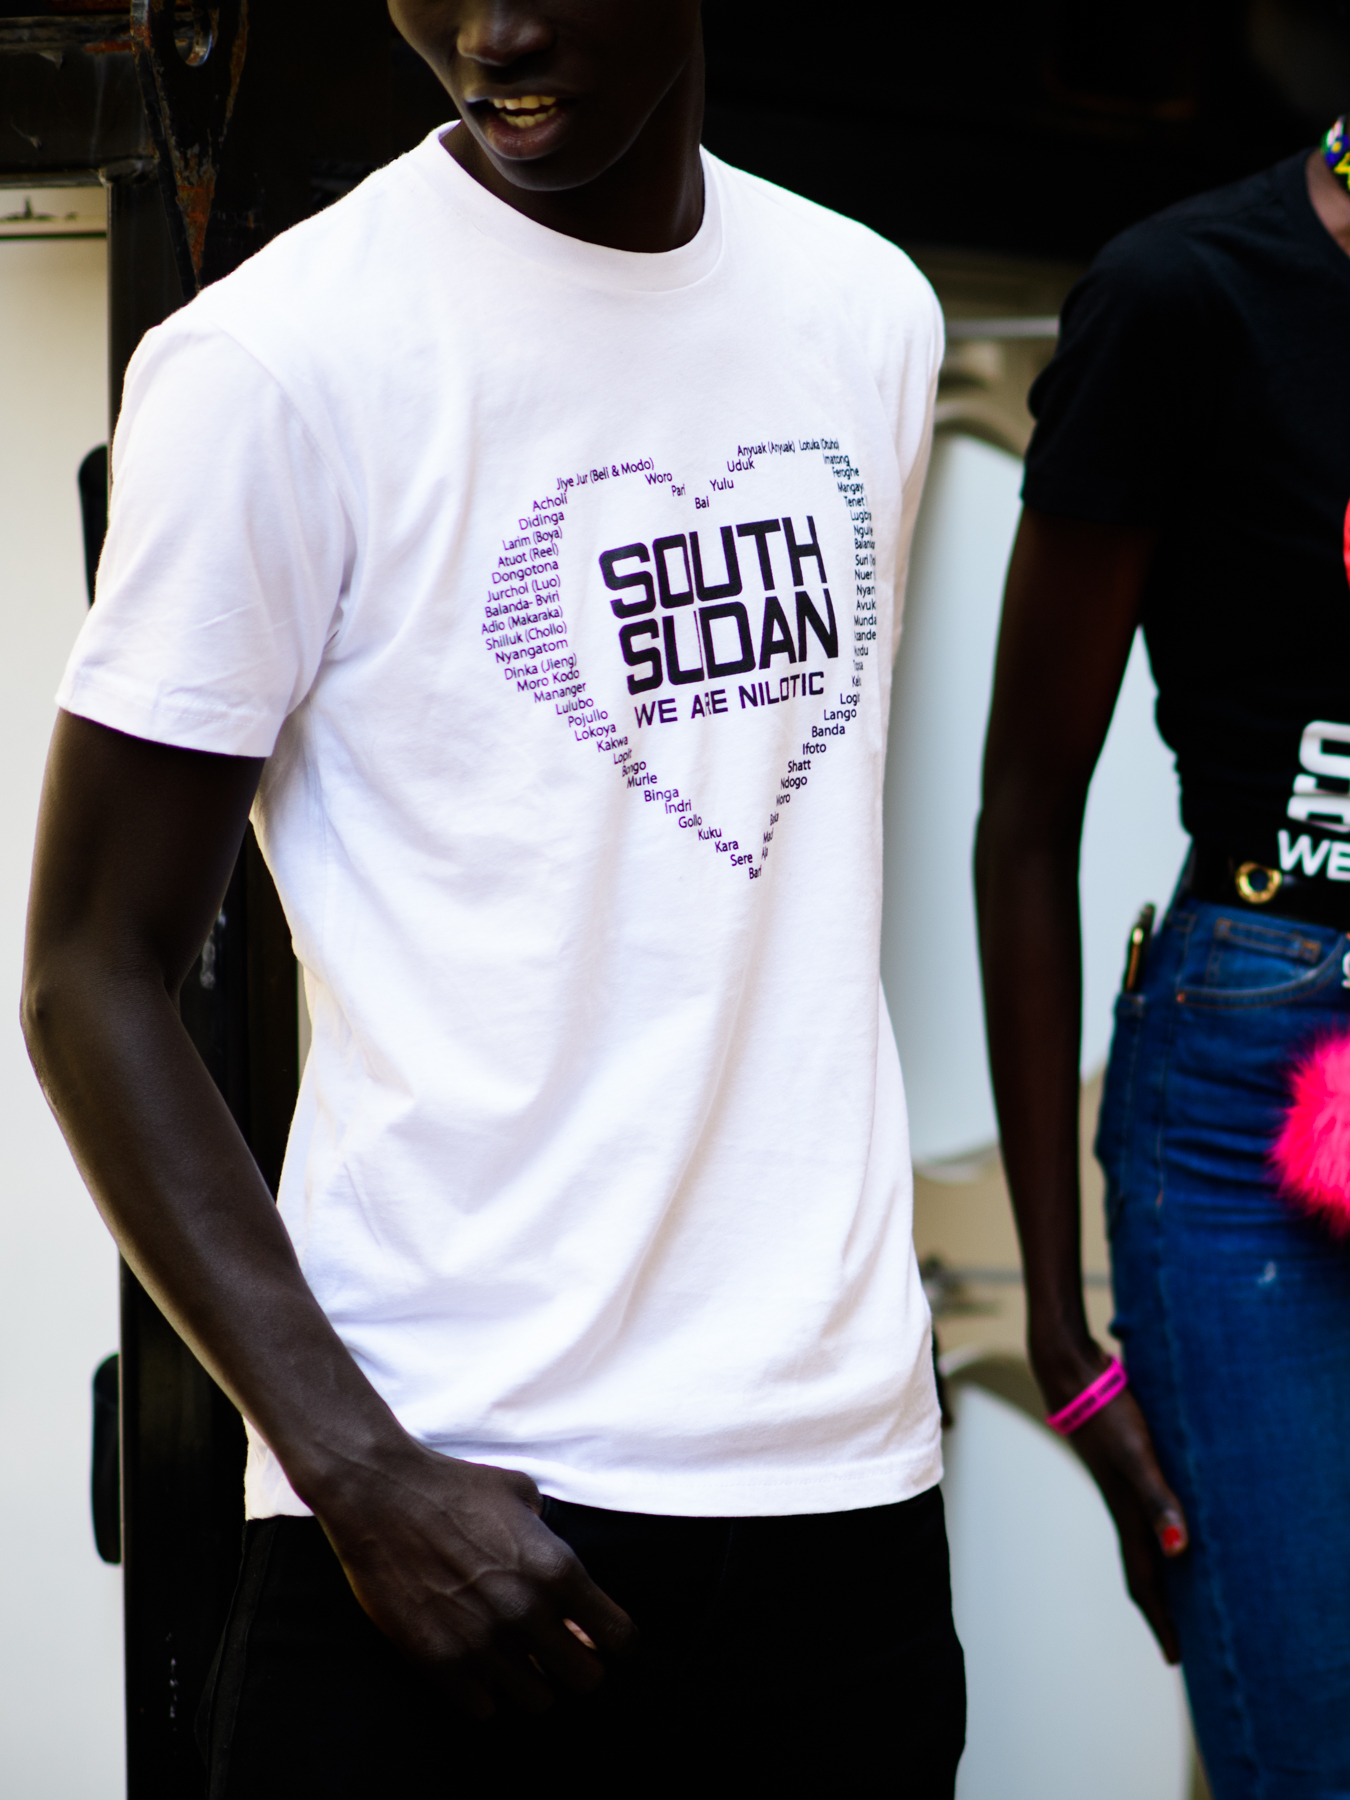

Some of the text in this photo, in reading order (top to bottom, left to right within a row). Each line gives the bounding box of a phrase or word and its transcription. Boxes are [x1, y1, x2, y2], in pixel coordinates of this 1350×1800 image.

[737, 442, 767, 459] Anyuak
[727, 458, 755, 472] Uduk
[557, 457, 654, 492] Jiye Jur (Beli & Modo)
[645, 472, 672, 485] Woro
[671, 484, 686, 497] Pari
[709, 478, 734, 492] Yulu
[532, 493, 568, 512] Acholi
[695, 496, 710, 509] Bai
[518, 511, 565, 531] Didinga
[502, 526, 562, 551] Larim (Boya)
[498, 543, 559, 568] Atuot (Reel)
[492, 560, 559, 584] Dongotona
[598, 515, 827, 619] SOUTH
[854, 569, 873, 581] Nuer
[487, 574, 561, 602] Jurchol (Luo)
[485, 591, 560, 618] Balanda- Bviri
[482, 605, 563, 635] Adio (Makaraka)
[486, 621, 567, 650] Shilluk (Chollo)
[618, 588, 839, 696] SUDAN
[495, 639, 568, 664] Nyangatom
[504, 653, 577, 680] Dinka (Jieng)
[517, 668, 580, 693] Moro Kodo
[534, 682, 586, 703] Mananger
[634, 698, 678, 729] WE
[739, 671, 825, 709] NILOTIC
[555, 698, 594, 715] Lulubo
[823, 708, 857, 722] Lango
[568, 709, 608, 728] Pojullo
[574, 724, 616, 742] Lokoya
[812, 723, 845, 737] Banda
[596, 736, 628, 753] Kakwa
[802, 742, 826, 755] Ifoto
[787, 759, 811, 773] Shatt
[627, 773, 658, 789] Murle
[780, 775, 808, 790] Ndogo
[644, 788, 679, 802] Binga
[664, 799, 692, 814] Indri
[678, 814, 703, 828] Gollo
[698, 827, 722, 841] Kuku
[714, 840, 739, 853] Kara
[730, 852, 753, 866] Sere
